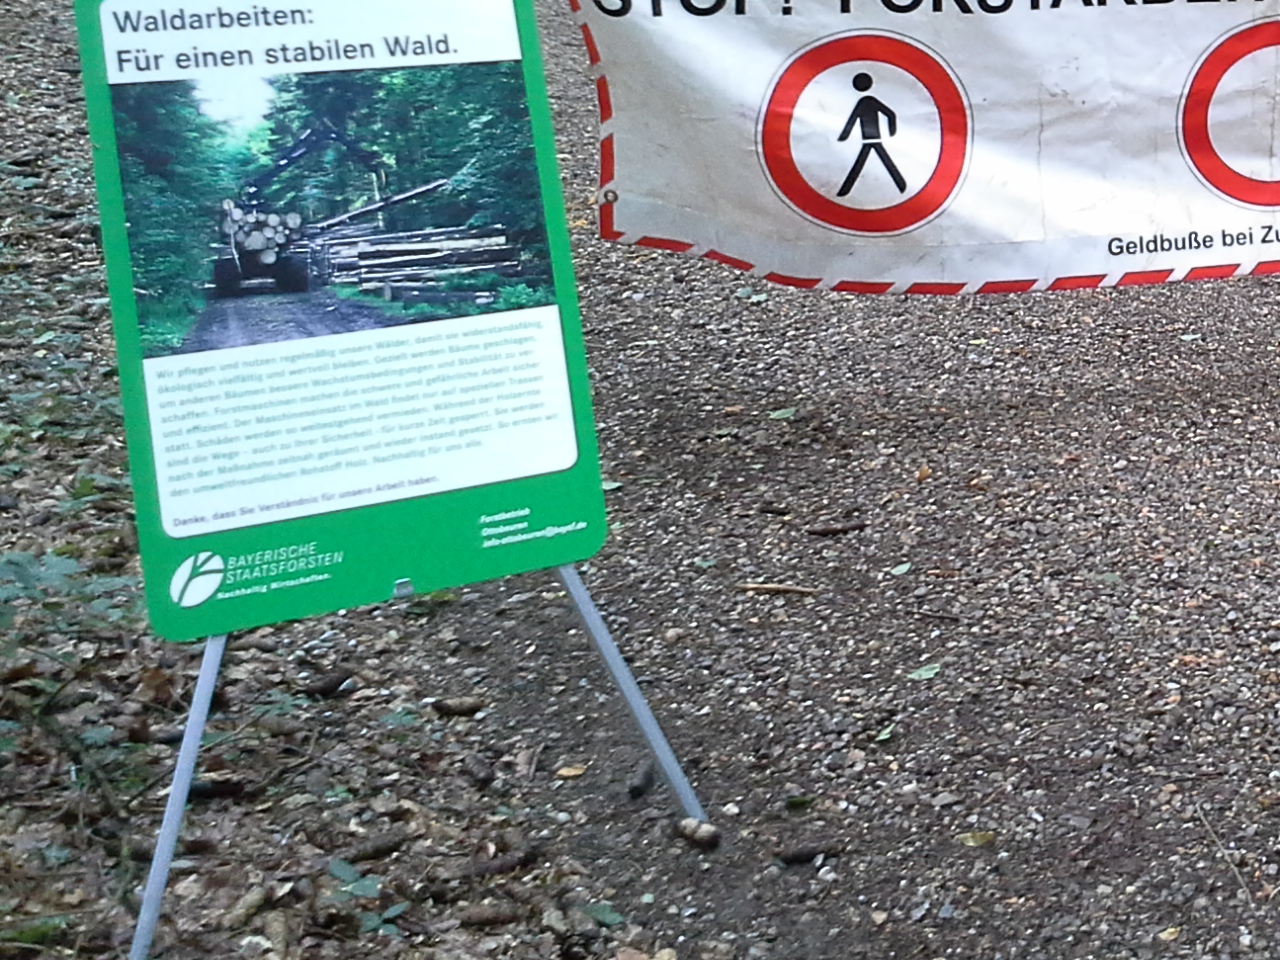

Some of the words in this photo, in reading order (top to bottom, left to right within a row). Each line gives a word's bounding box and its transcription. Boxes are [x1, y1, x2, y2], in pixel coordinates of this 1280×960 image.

[112, 5, 314, 34] Waldarbeiten:
[116, 49, 164, 73] Für
[175, 46, 254, 69] einen
[265, 38, 375, 65] stabilen
[383, 33, 459, 58] Wald.
[1107, 231, 1214, 256] Geldbuße
[1221, 227, 1254, 248] bei
[225, 551, 345, 584] STAATSFORSTEN
[227, 542, 318, 569] BAYERISCHE
